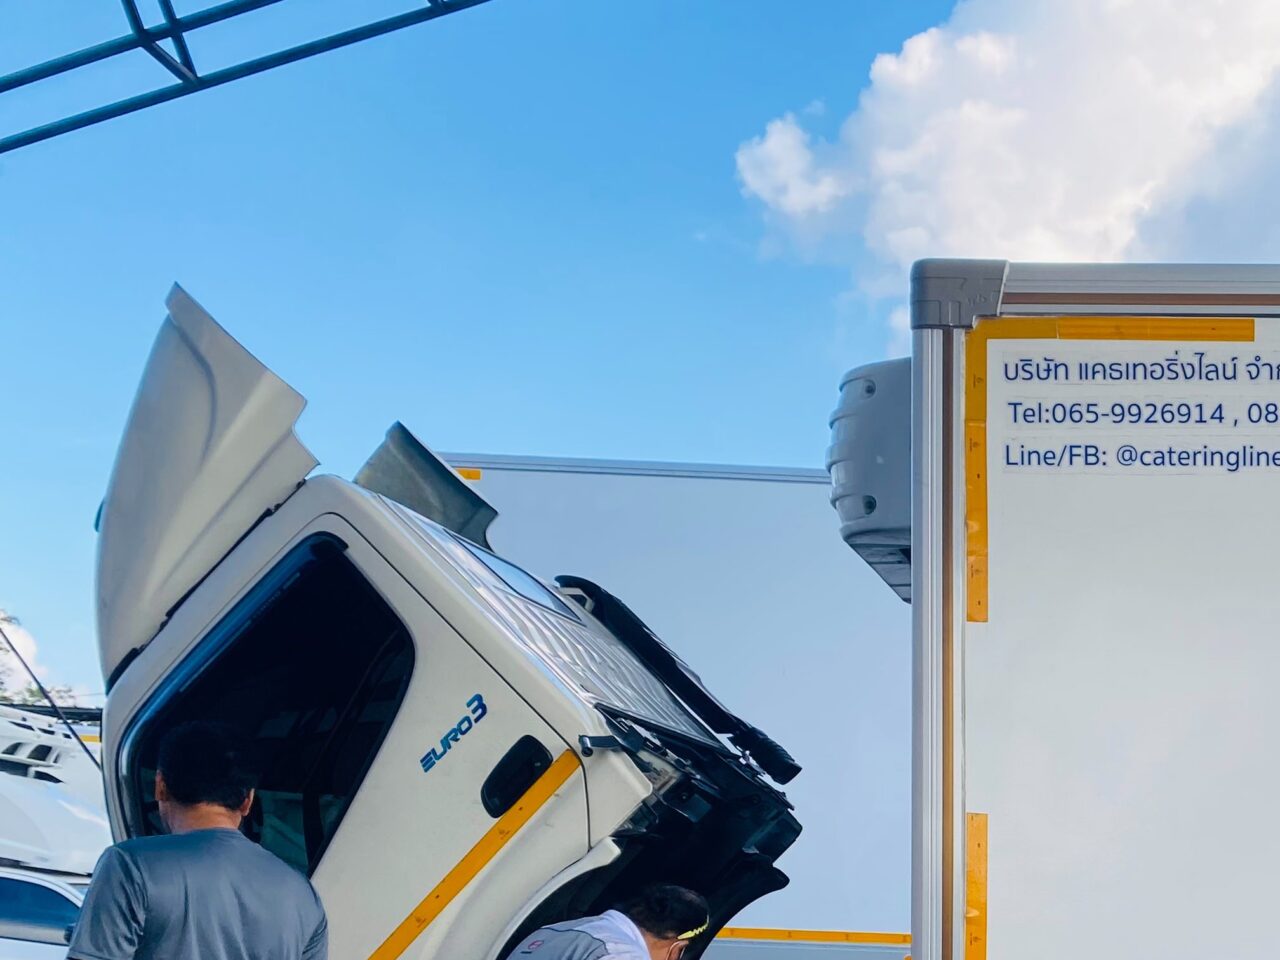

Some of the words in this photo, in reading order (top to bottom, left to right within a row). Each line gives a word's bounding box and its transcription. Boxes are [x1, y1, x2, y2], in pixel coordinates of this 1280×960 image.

[1004, 356, 1069, 381] บริษัท
[1007, 402, 1226, 424] Tel:065-9926914
[1005, 444, 1108, 468] Line/FB:
